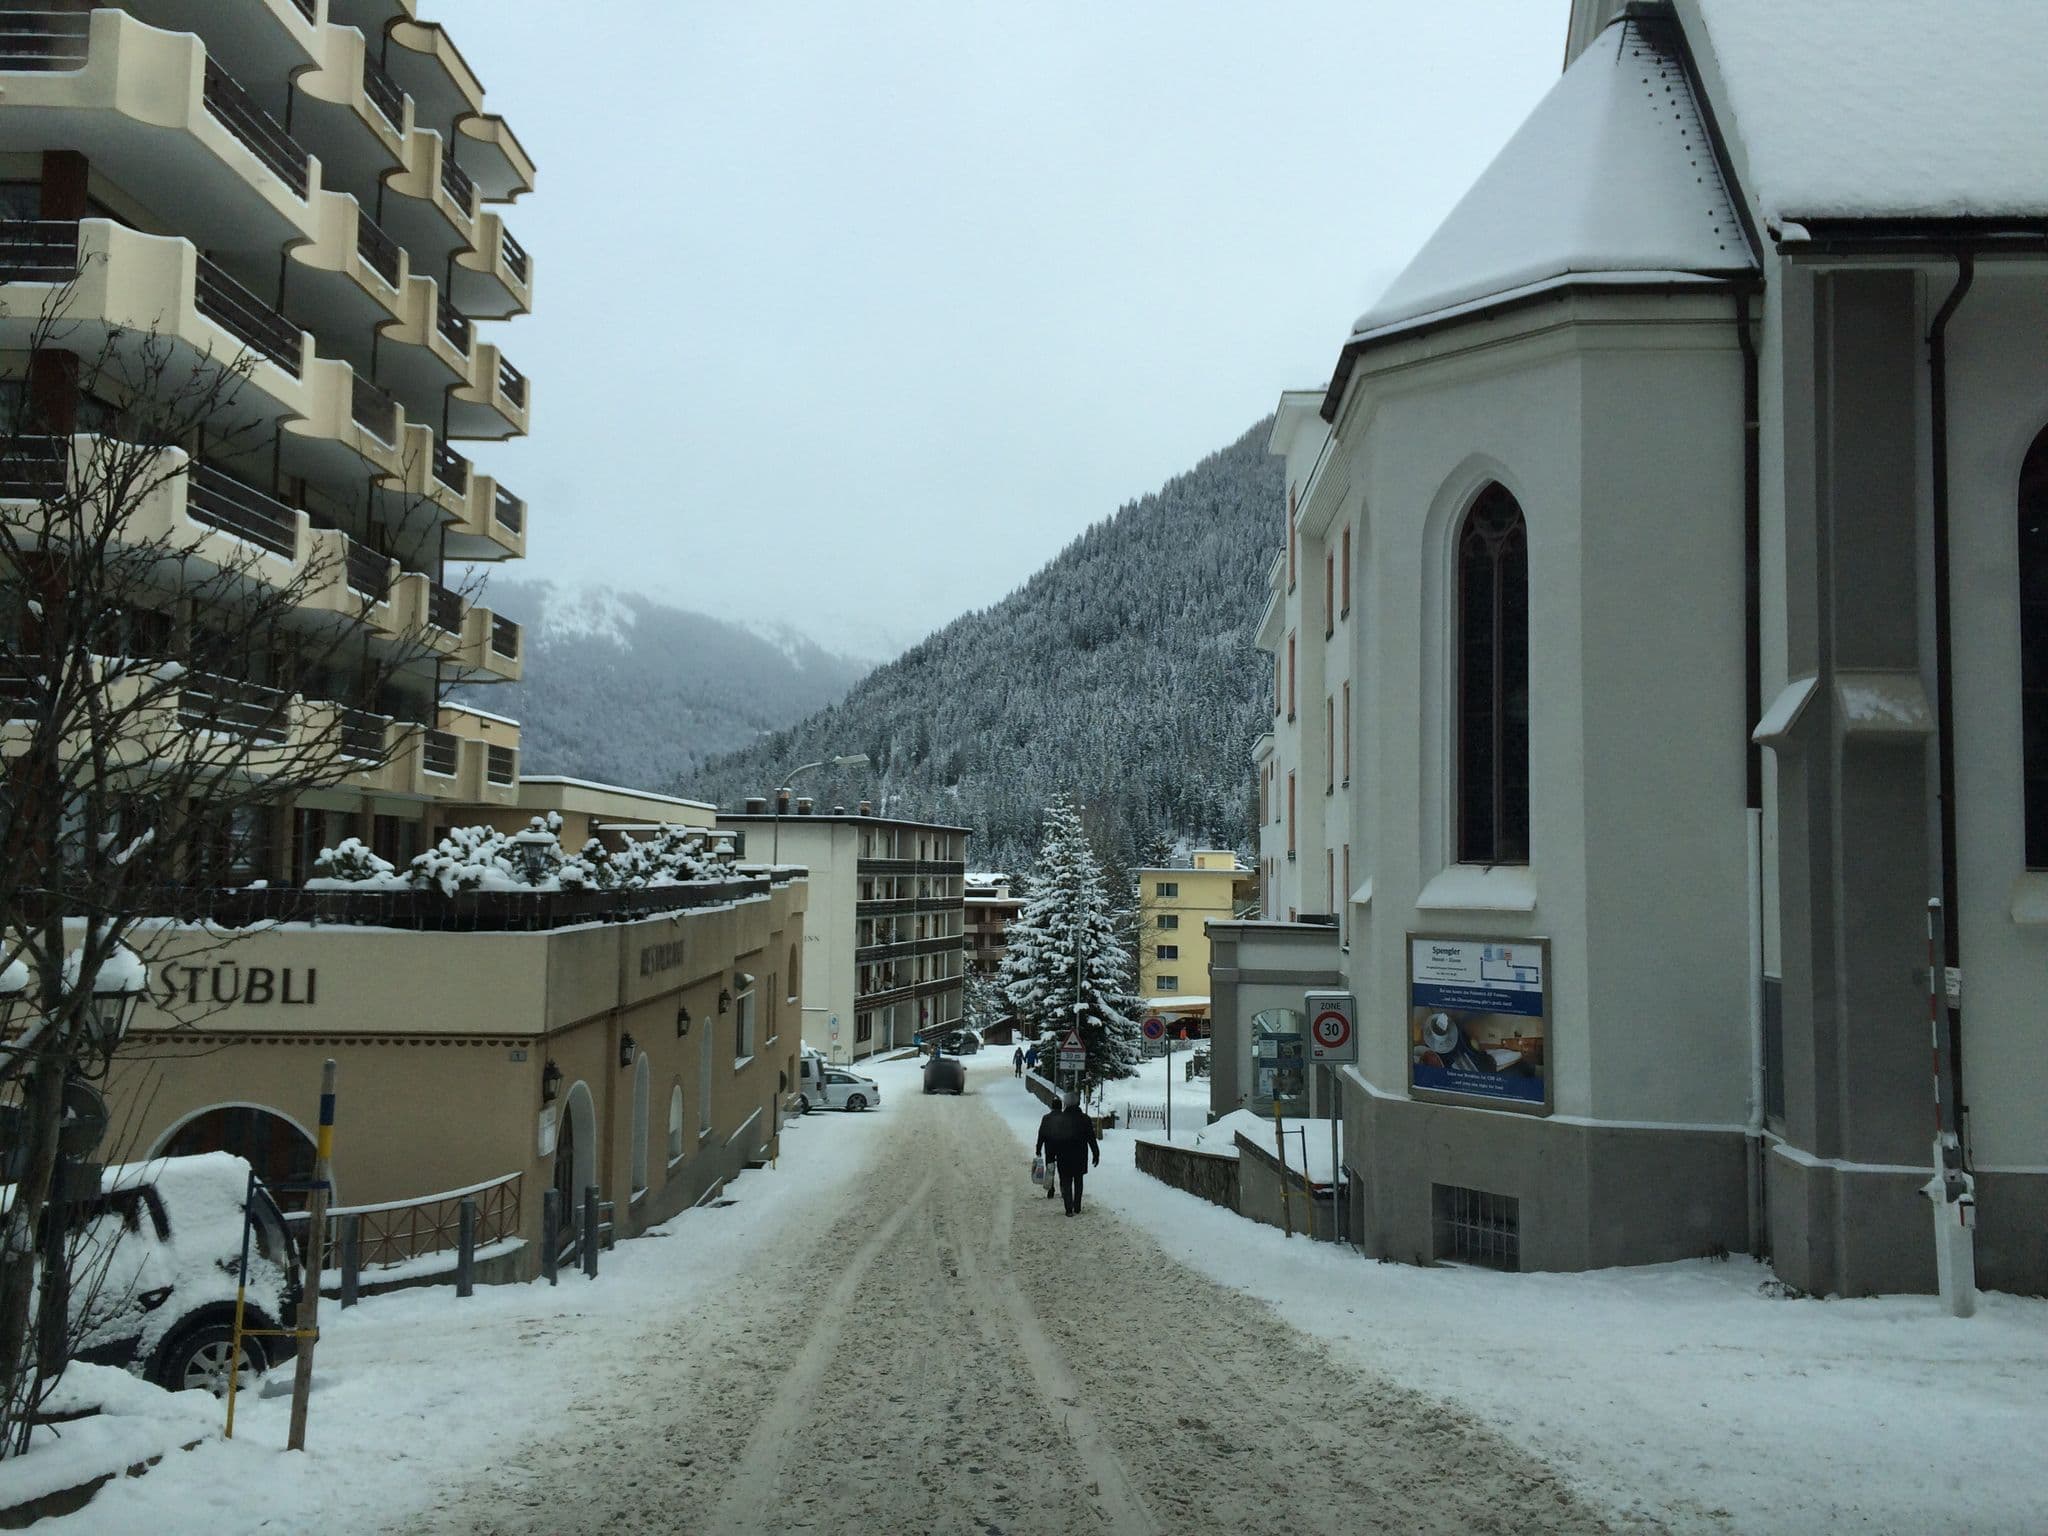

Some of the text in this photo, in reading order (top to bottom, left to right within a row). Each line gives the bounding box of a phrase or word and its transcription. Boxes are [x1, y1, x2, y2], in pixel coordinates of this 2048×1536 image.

[1432, 946, 1461, 956] Spengler
[1320, 1002, 1342, 1010] ZONE
[1324, 1023, 1339, 1037] 30
